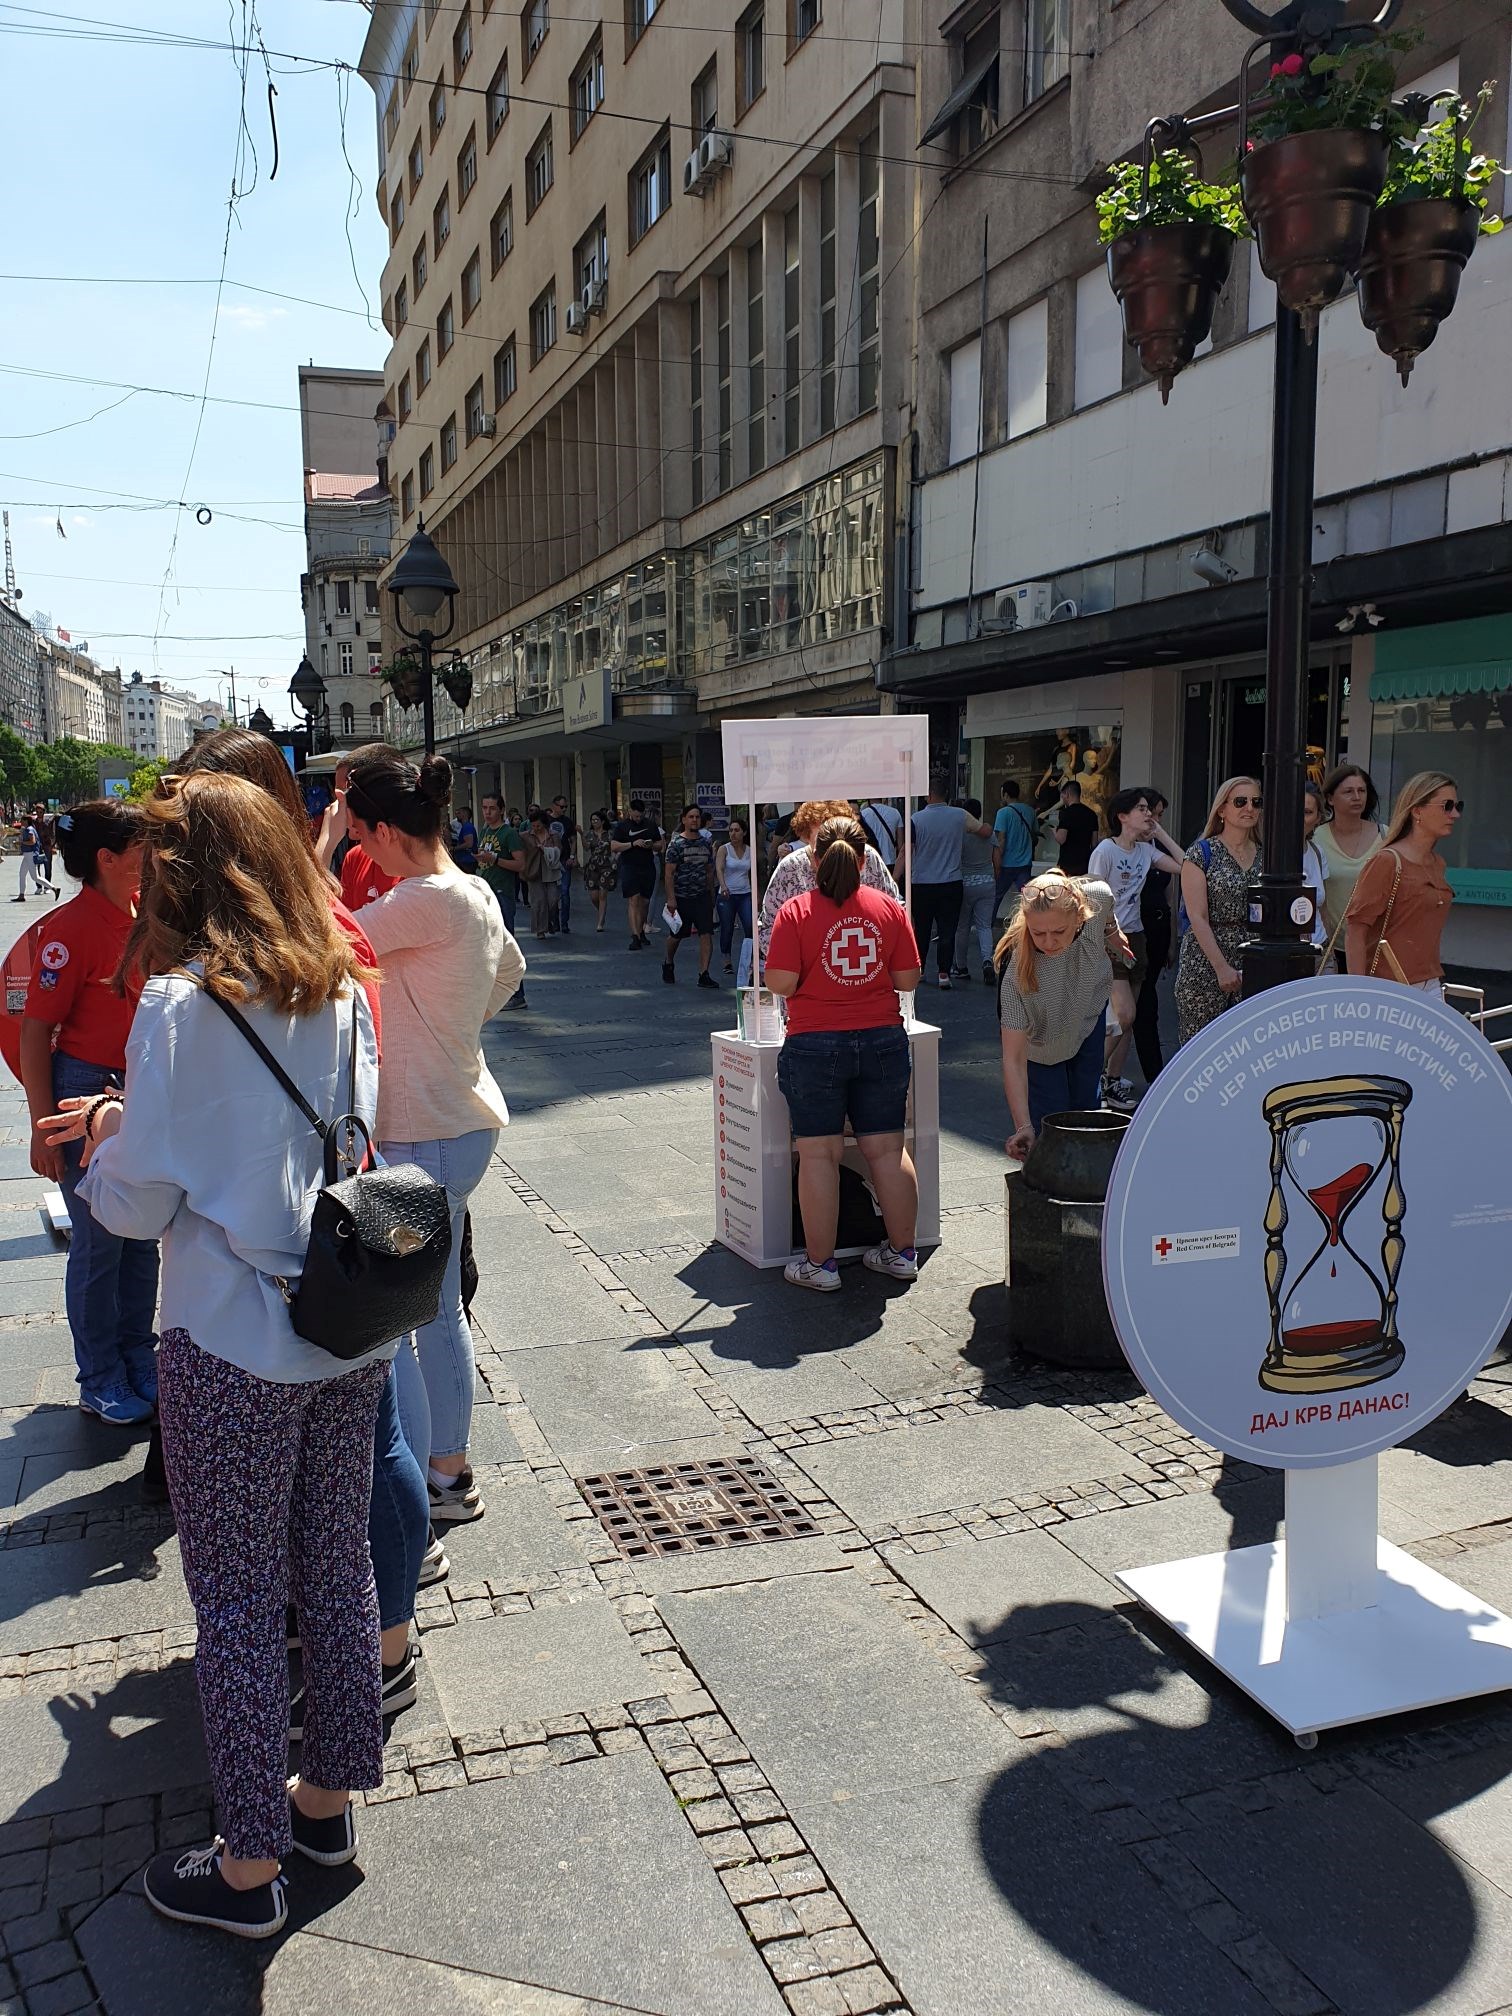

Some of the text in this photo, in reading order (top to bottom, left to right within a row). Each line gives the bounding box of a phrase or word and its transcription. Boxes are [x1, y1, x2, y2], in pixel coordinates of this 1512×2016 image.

[843, 916, 862, 924] КРСТ
[837, 978, 853, 987] КРСТ
[1183, 1002, 1488, 1104] ОКРЕНИ САВЕСТ КАО ПЕШЧАНИ САТ
[1219, 1030, 1459, 1107] ЈЕР НЕЧИЈЕ ВРЕМЕ ИСТИЧЕ
[1212, 1241, 1236, 1249] Belgrade
[1250, 1392, 1409, 1434] ДАЈ КРВ ДАНАС!
